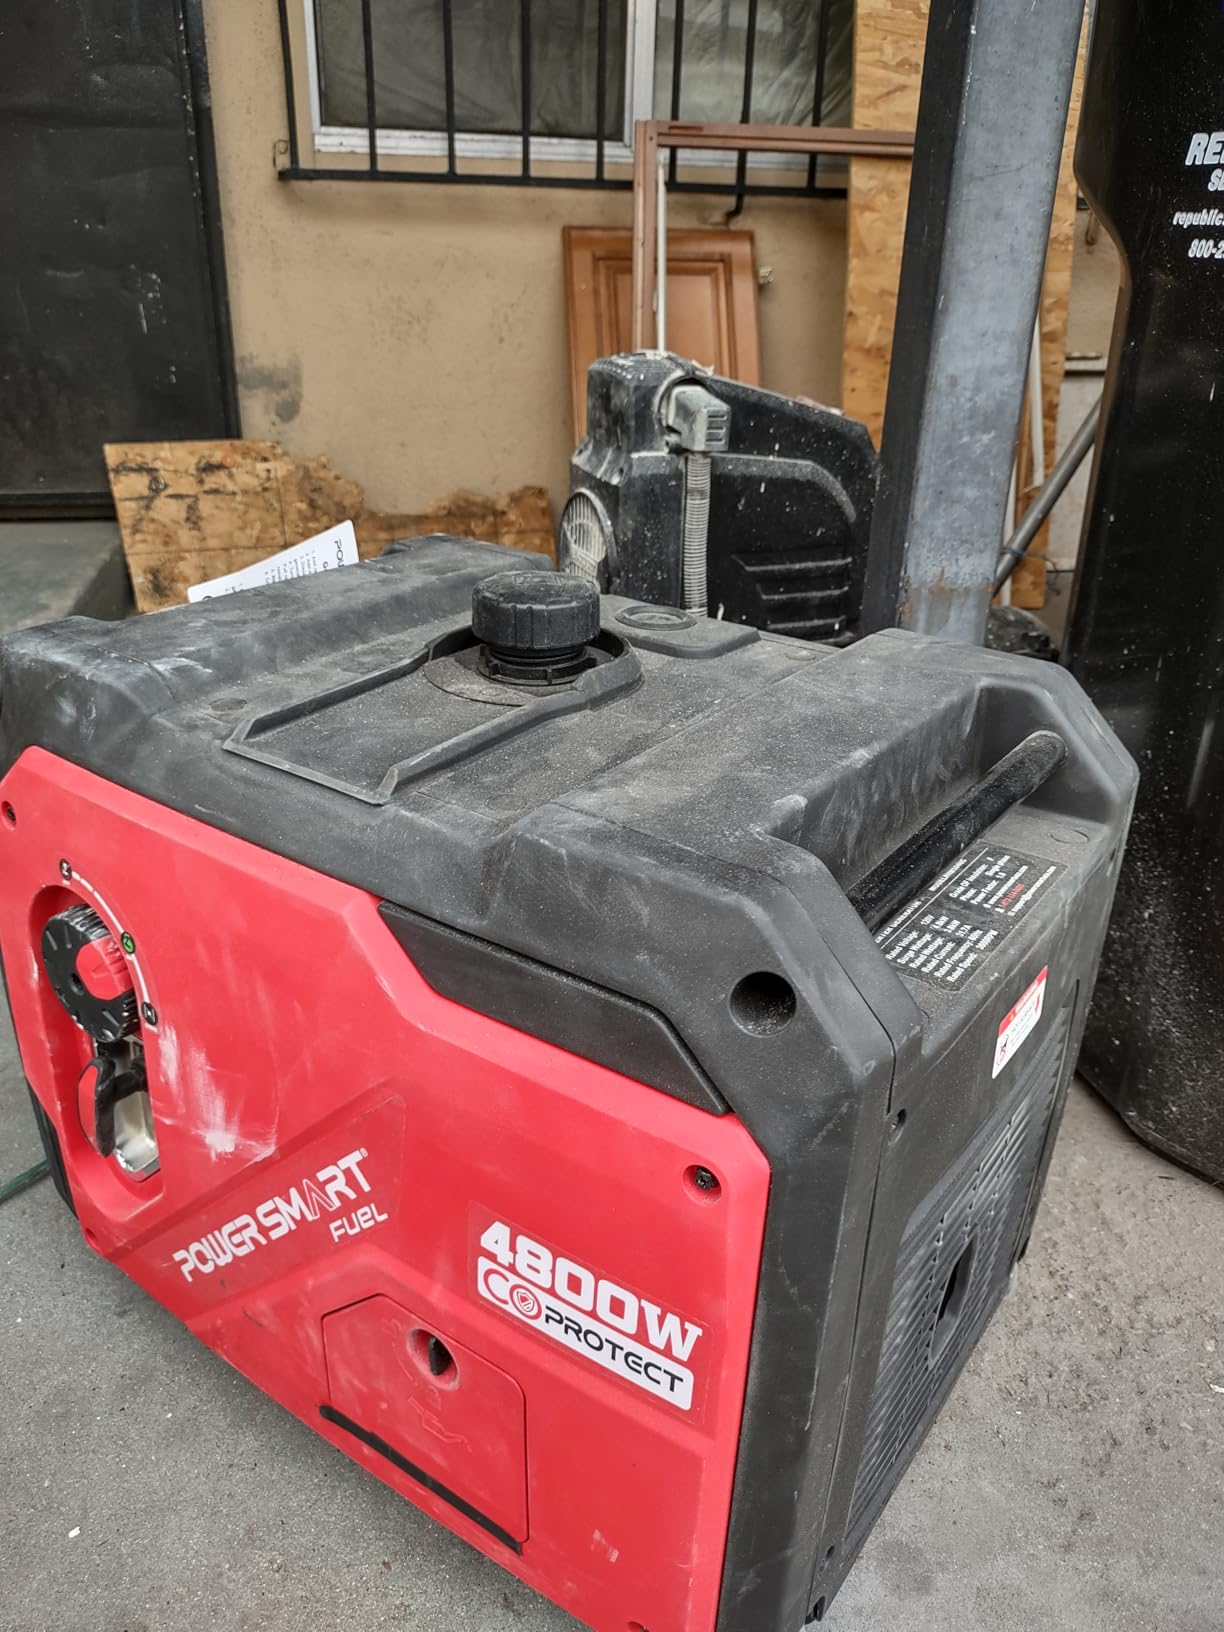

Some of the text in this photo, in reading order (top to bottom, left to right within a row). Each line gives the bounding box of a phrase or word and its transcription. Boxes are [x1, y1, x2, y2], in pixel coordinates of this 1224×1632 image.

[1185, 131, 1224, 165] RE
[1172, 208, 1224, 229] republic
[1188, 238, 1224, 259] 800-2
[970, 892, 986, 904] Power
[886, 946, 902, 959] Rated
[897, 950, 915, 964] Surge
[909, 954, 927, 968] Rated
[921, 958, 939, 973] Rated
[934, 962, 952, 977] Rated
[946, 967, 964, 982] Rated
[480, 1221, 703, 1362] 4800W
[545, 1305, 684, 1393] PROTECT
